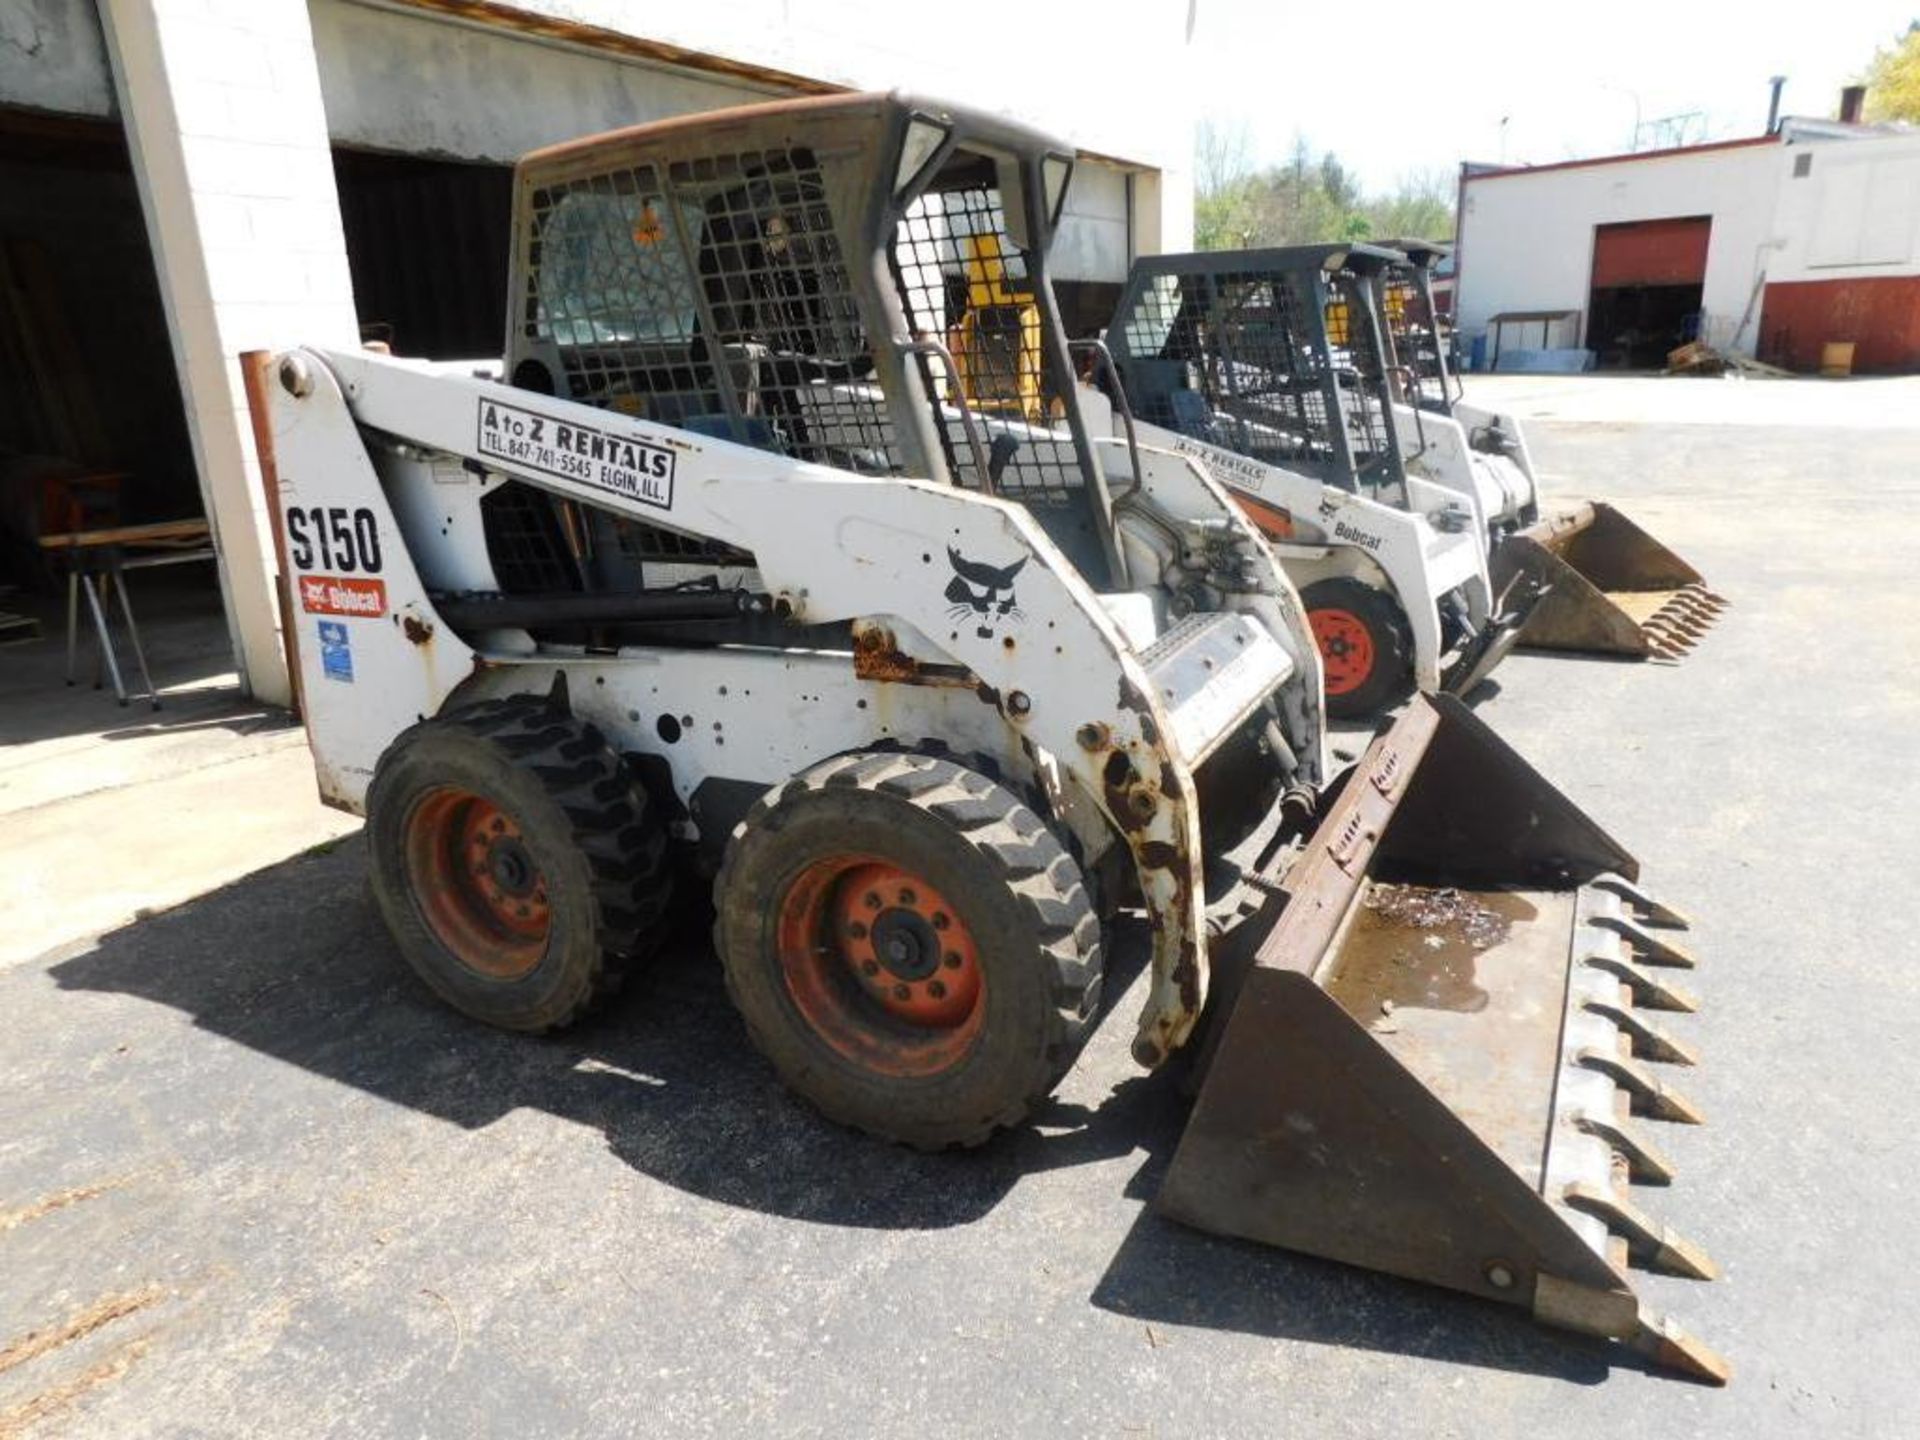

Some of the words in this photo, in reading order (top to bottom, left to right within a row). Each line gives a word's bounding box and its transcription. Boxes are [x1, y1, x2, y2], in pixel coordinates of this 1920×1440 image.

[484, 406, 499, 430] A
[503, 415, 524, 437] to
[529, 418, 544, 443] Z
[557, 426, 668, 478] RENTALS
[287, 507, 382, 573] S150
[1334, 521, 1381, 551] Bobcat
[329, 586, 381, 611] Bobcat
